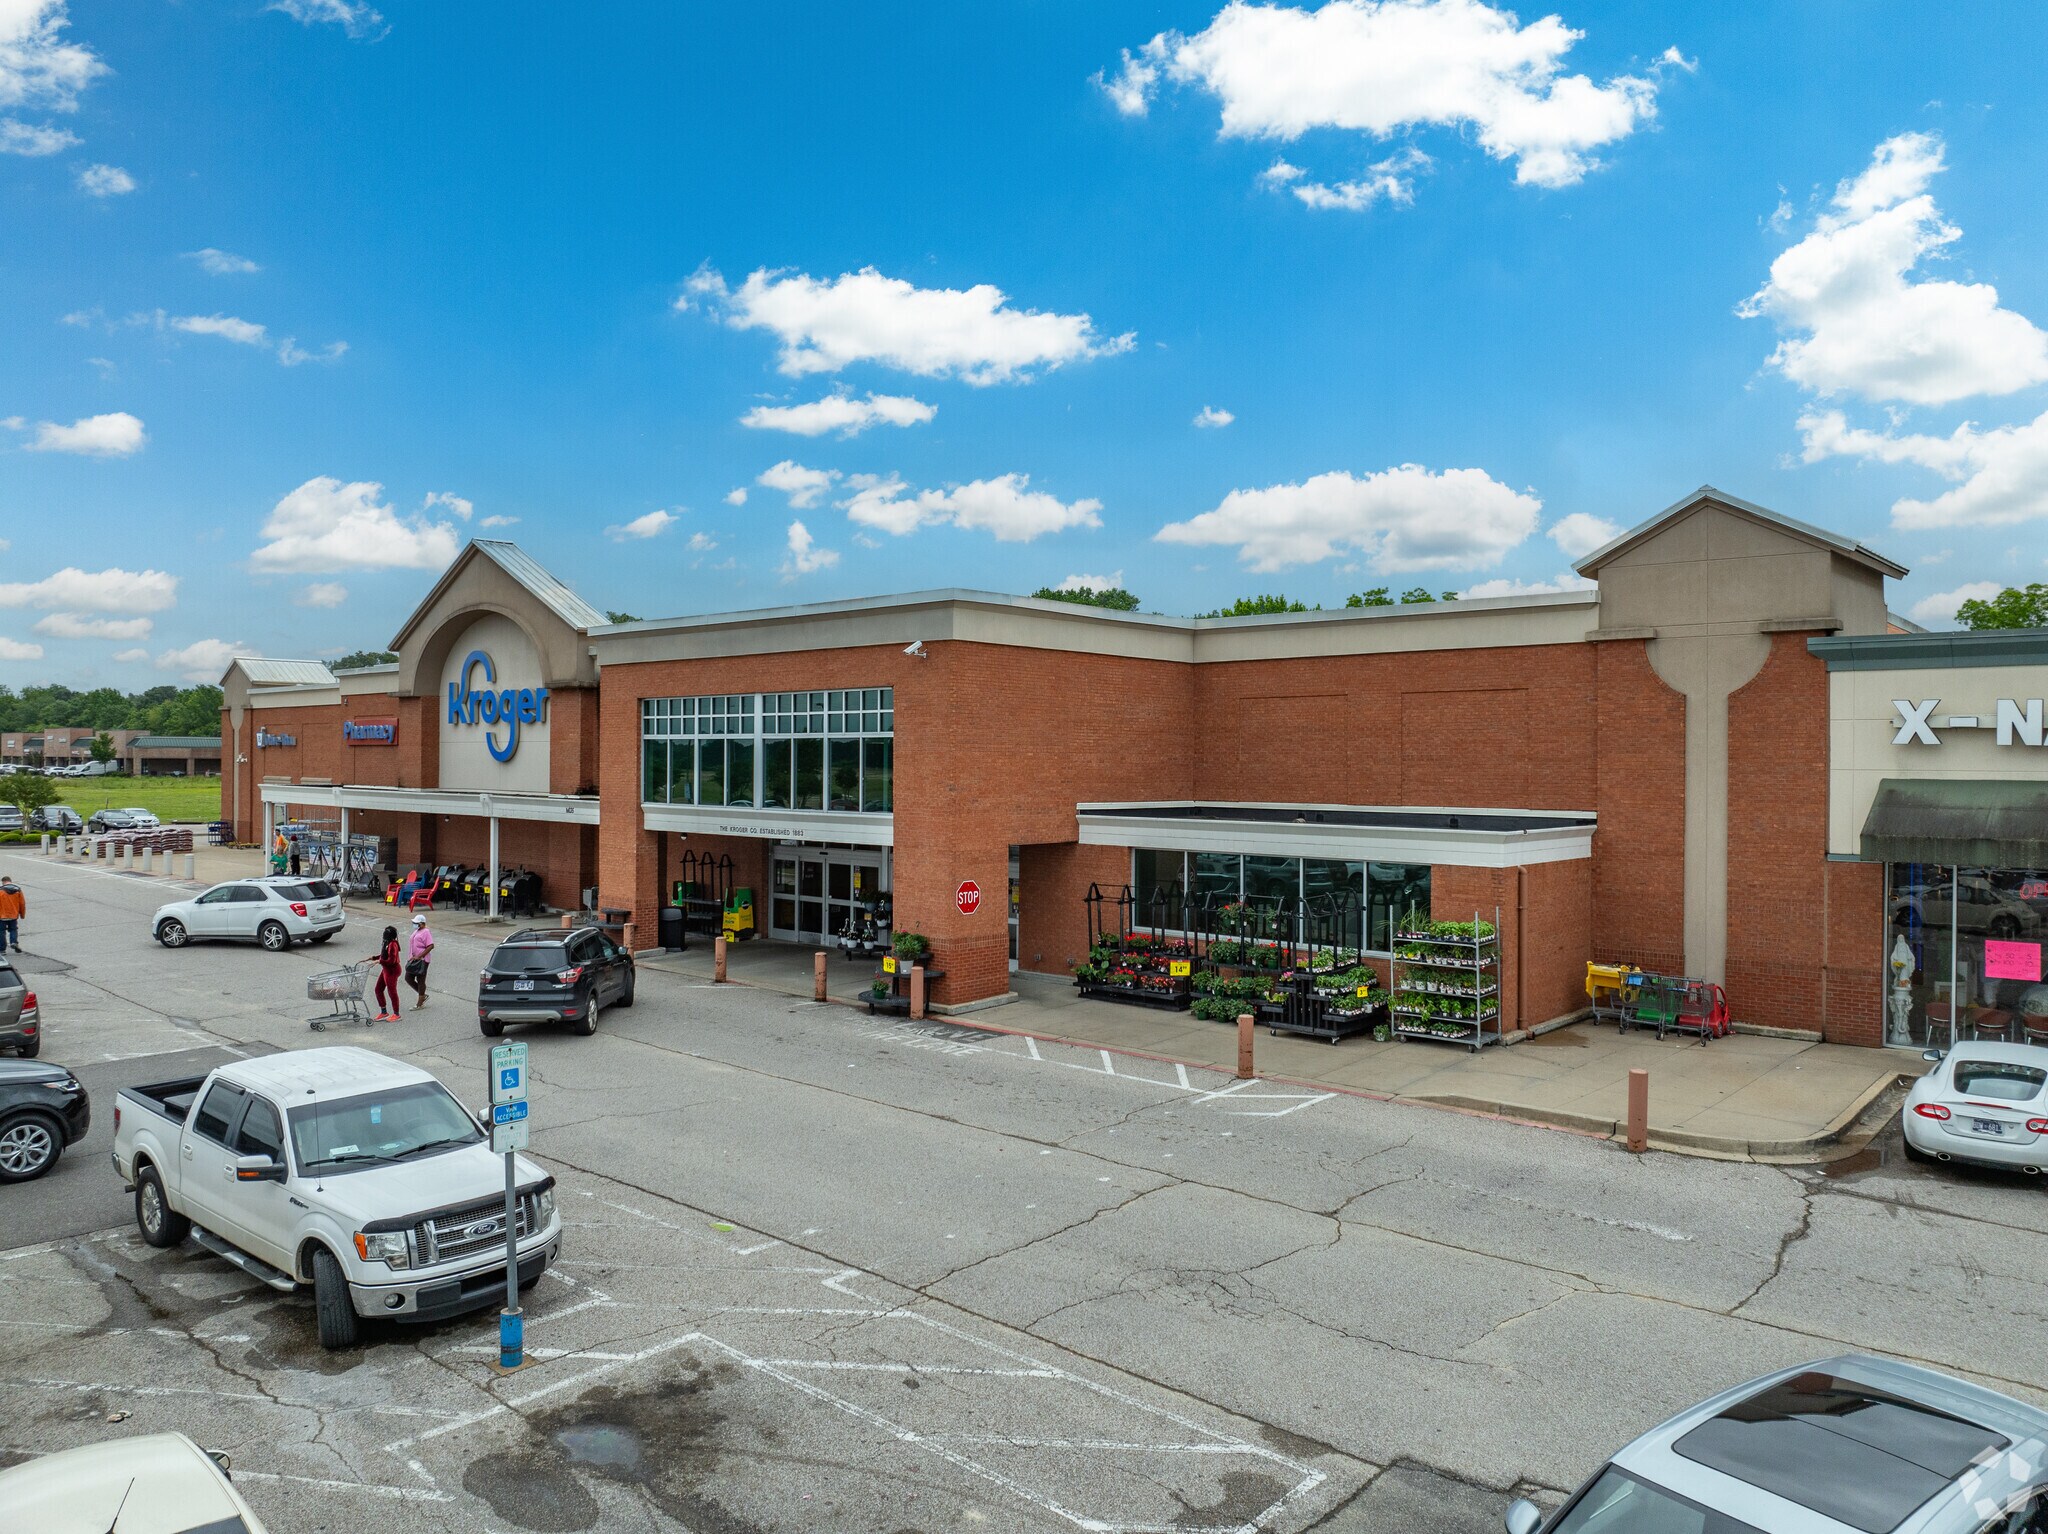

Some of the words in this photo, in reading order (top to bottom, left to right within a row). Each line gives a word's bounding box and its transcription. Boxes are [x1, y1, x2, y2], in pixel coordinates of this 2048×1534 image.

[448, 650, 551, 763] Kroger
[1891, 699, 2048, 746] X-N
[343, 720, 395, 744] Pharmacy
[729, 826, 749, 834] KROGER
[759, 828, 791, 836] ESTABLISHED
[958, 890, 979, 905] STOP
[494, 1047, 525, 1059] RESERVED
[496, 1057, 524, 1069] PARKING
[496, 1109, 527, 1122] ACCESSIBLE
[477, 1223, 492, 1234] Ford
